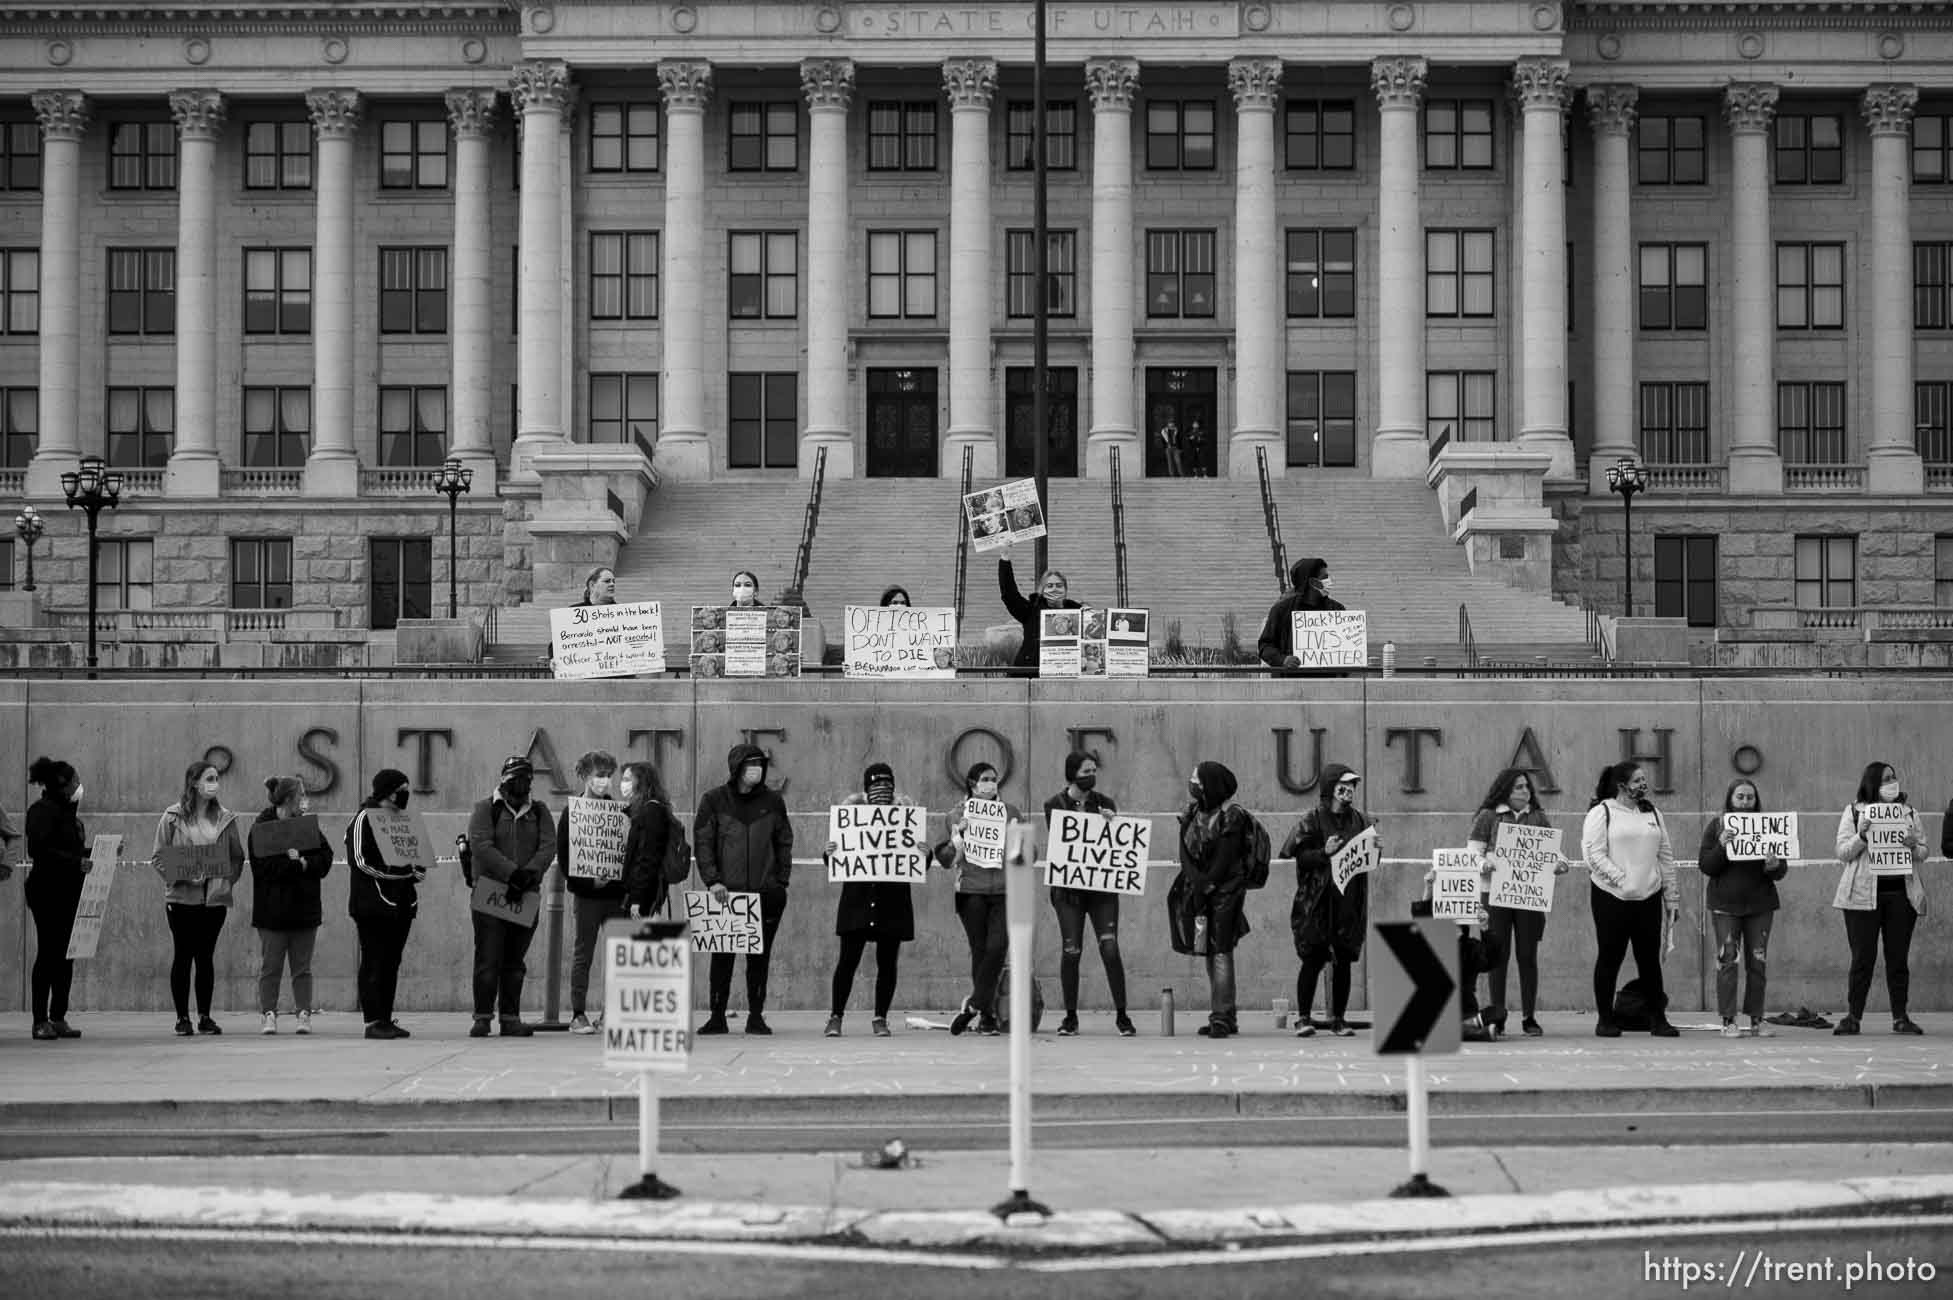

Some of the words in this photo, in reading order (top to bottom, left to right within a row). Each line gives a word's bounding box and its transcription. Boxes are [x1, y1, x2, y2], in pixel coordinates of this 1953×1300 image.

[887, 10, 1004, 32] STATE
[1093, 10, 1193, 32] UTAH
[573, 608, 588, 624] 30
[625, 607, 636, 616] the
[639, 603, 658, 616] back!
[937, 612, 952, 632] I
[1294, 611, 1328, 629] Black
[1334, 611, 1365, 625] Brown
[561, 630, 593, 640] Bernardo
[597, 624, 619, 632] should
[606, 634, 622, 645] NOT
[909, 632, 952, 649] WANT
[648, 650, 656, 658] to
[872, 649, 892, 662] TO
[898, 648, 929, 661] DIE
[1302, 650, 1363, 665] MATTER
[1271, 726, 1675, 797] UTAH
[574, 800, 581, 810] A
[585, 801, 606, 811] MAN
[968, 800, 1004, 818] BLACK
[571, 810, 606, 828] STANDS
[607, 814, 624, 828] FOR
[837, 806, 918, 829] BLACK
[1728, 815, 1790, 836] SILENCE
[577, 823, 624, 841] NOTHING
[841, 828, 916, 852] LIVES
[969, 824, 999, 841] LIVES
[1061, 815, 1147, 850] BLACK
[1507, 825, 1516, 835] IF
[1518, 827, 1535, 837] YOU
[1538, 829, 1556, 839] ARE
[1872, 830, 1905, 844] LIVES
[571, 837, 595, 848] WILL
[595, 838, 616, 851] FALL
[964, 841, 1004, 859] MATTER
[1515, 836, 1544, 850] NOT
[1730, 839, 1790, 857] VIOLENCE
[577, 847, 625, 864] ANYTHING
[1067, 844, 1139, 869] LIVES
[1438, 853, 1478, 867] BLACK
[1495, 846, 1559, 864] OUTRAGED
[1868, 851, 1912, 865] MATTER
[831, 852, 923, 878] MATTER
[1339, 852, 1370, 885] SHOOT
[1507, 860, 1525, 869] YOU
[1527, 861, 1545, 872] ARE
[1048, 861, 1142, 891] MATTER
[1511, 869, 1539, 882] NOT
[1441, 879, 1475, 893] LIVES
[1502, 881, 1544, 897] PAYING
[685, 892, 760, 924] BLACK
[1495, 893, 1549, 908] ATTENTION
[691, 934, 761, 953] MATTER
[615, 944, 684, 968] BLACK
[619, 988, 678, 1013] LIVES
[607, 1028, 688, 1052] MATTER
